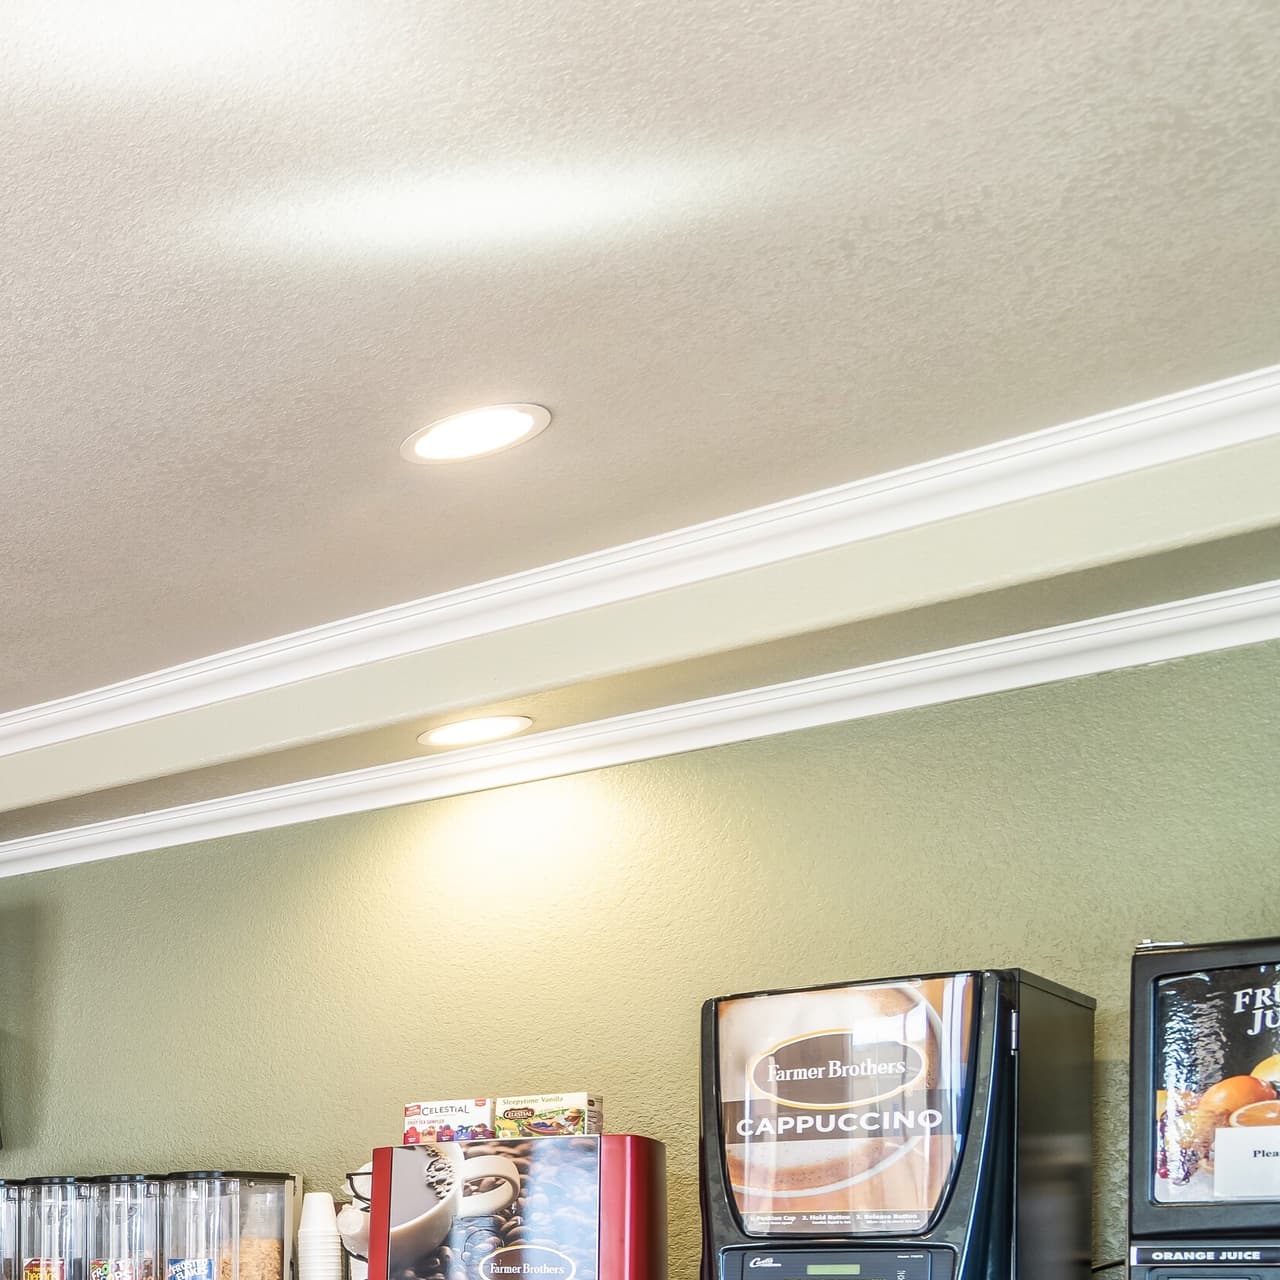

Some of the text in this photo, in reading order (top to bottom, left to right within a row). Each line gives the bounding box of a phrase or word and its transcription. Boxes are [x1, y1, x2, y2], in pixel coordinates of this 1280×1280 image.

[767, 1058, 906, 1081] Farmer Brothers
[502, 1098, 539, 1106] Sleepytime
[421, 1105, 470, 1116] CELESTIAL
[736, 1109, 943, 1137] CAPPUCCINO
[1152, 1251, 1261, 1260] ORANGE JUICE
[490, 1262, 565, 1274] Farmer Brothers
